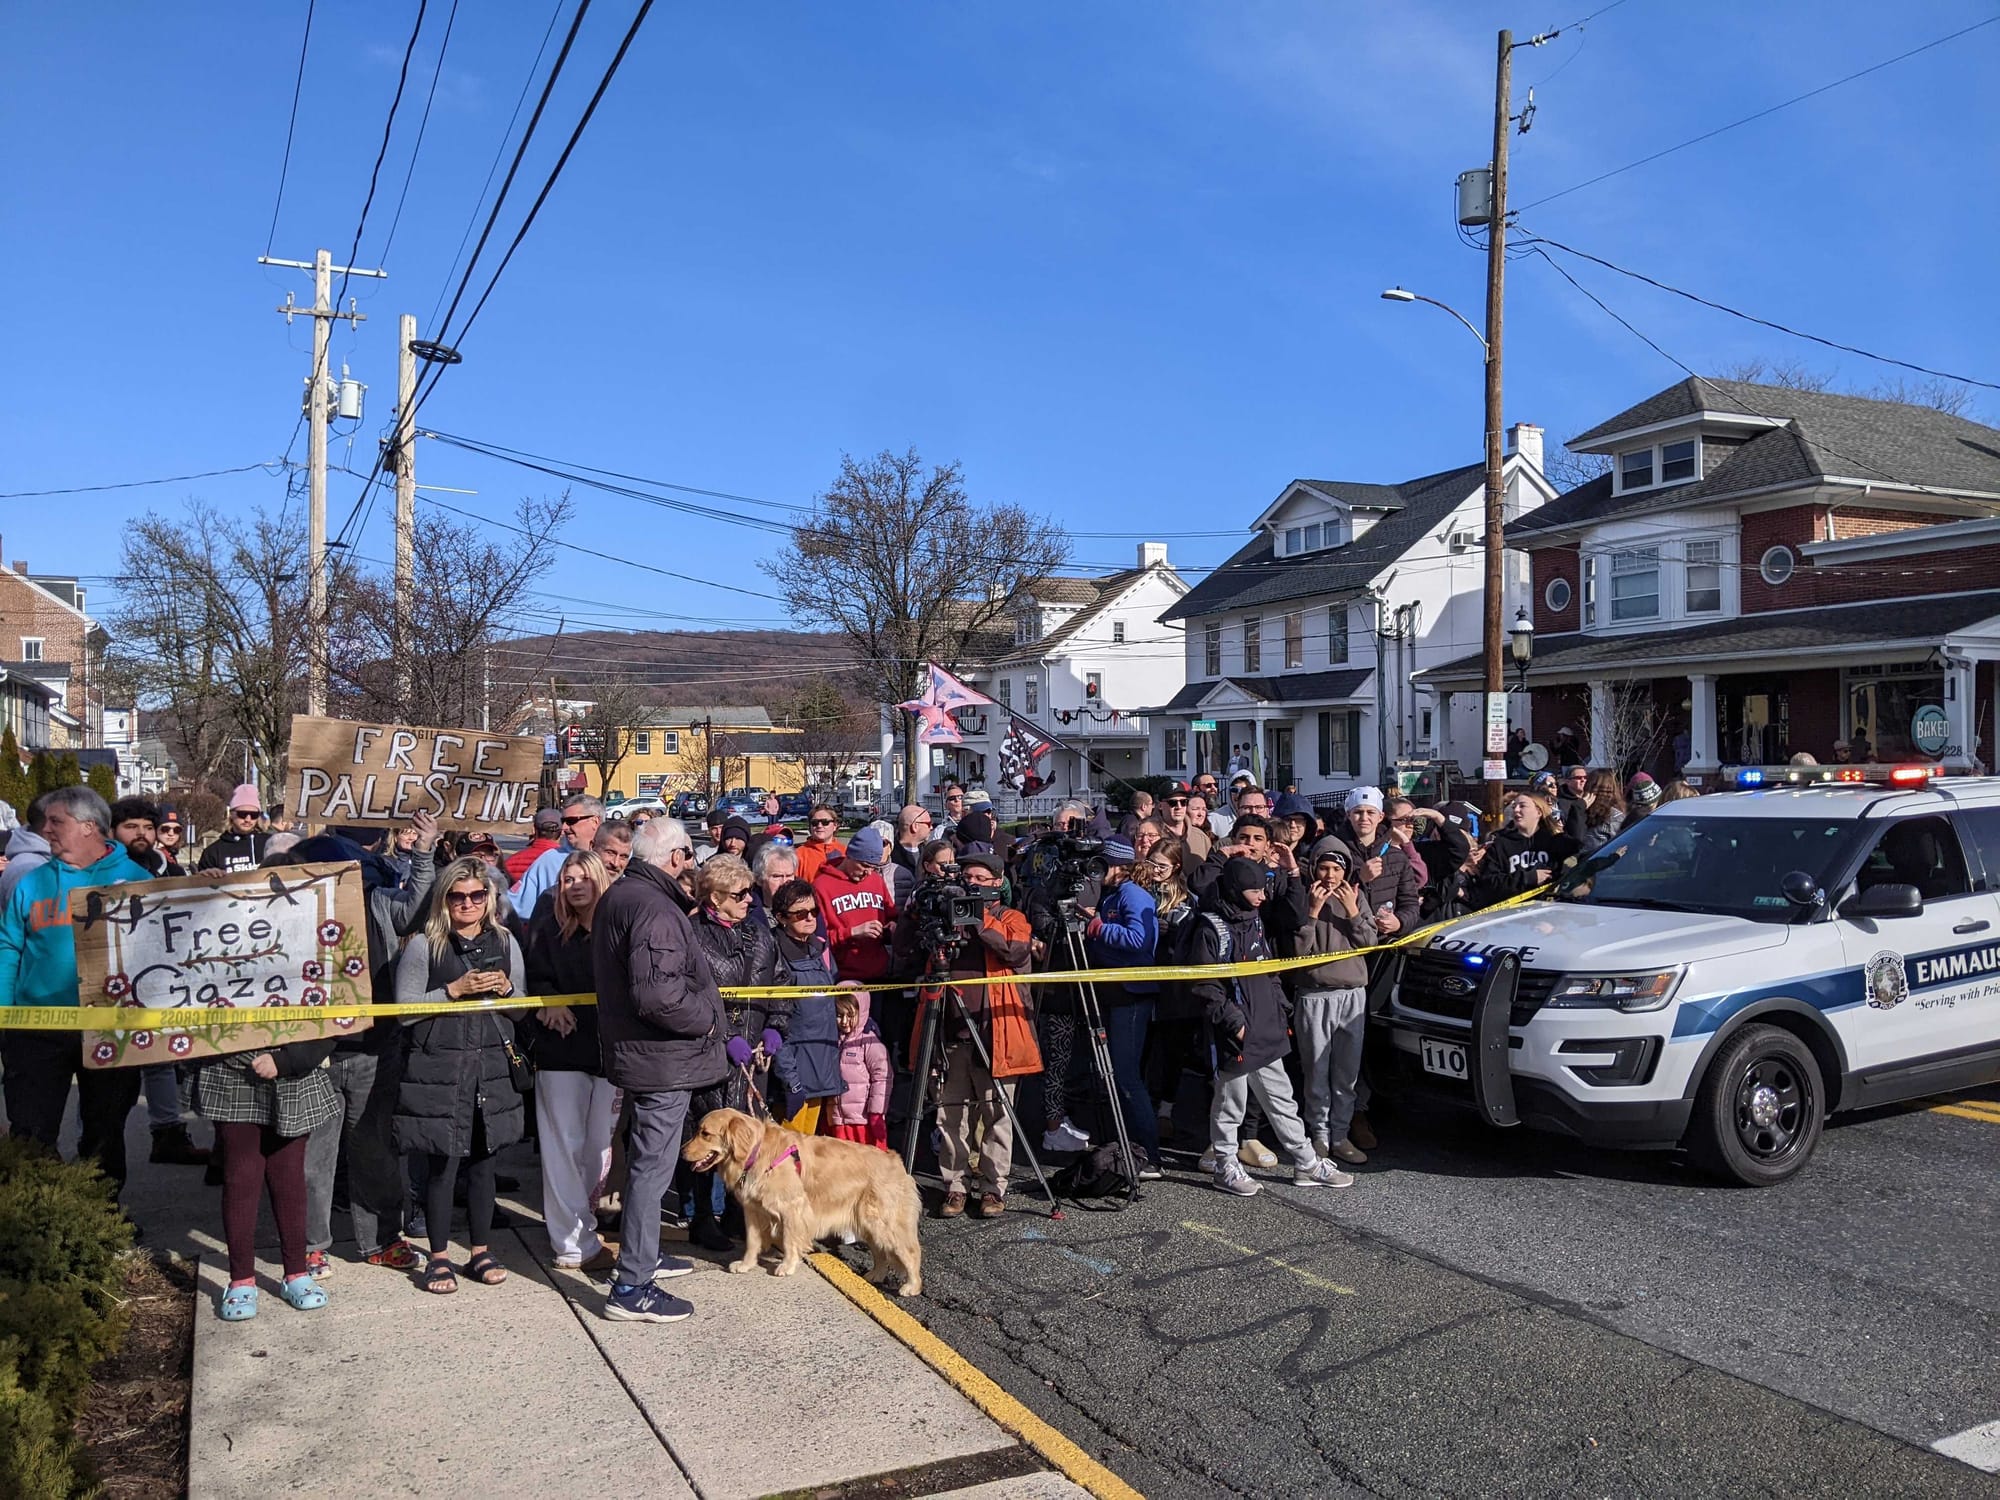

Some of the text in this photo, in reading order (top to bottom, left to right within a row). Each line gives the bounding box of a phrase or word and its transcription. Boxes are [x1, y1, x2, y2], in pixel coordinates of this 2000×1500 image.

[1917, 720, 1950, 738] BAKED
[353, 726, 508, 776] FREE
[1944, 745, 1963, 757] 228
[296, 767, 540, 824] PALESTINE
[225, 855, 250, 866] I am
[1509, 850, 1549, 874] POLO
[831, 891, 885, 915] TEMPLE
[162, 911, 273, 953] Free
[131, 963, 289, 1009] Gaza
[1960, 987, 1981, 1001] with
[1424, 1045, 1466, 1073] 110
